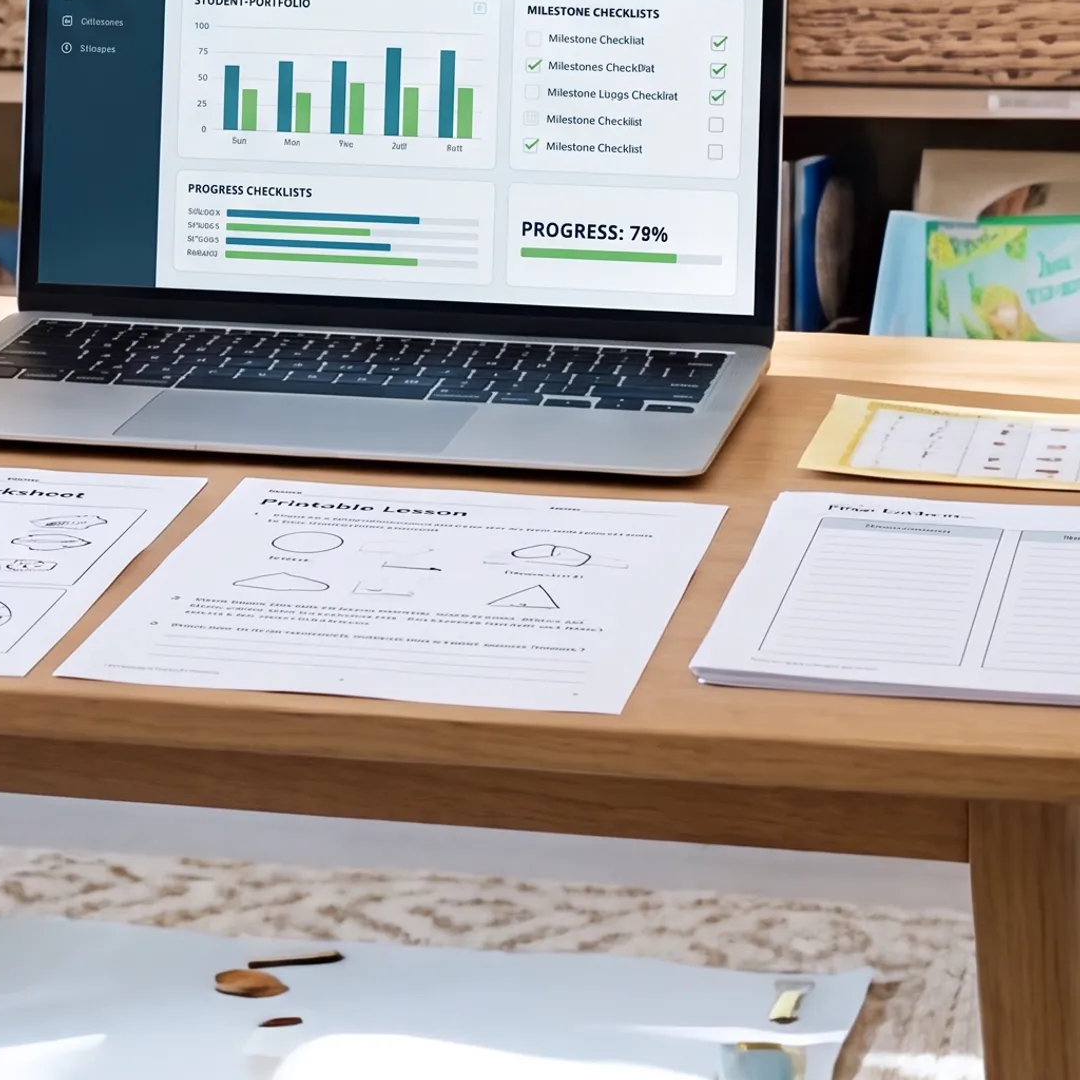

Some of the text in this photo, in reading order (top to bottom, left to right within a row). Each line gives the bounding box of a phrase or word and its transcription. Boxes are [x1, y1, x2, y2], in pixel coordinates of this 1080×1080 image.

[527, 5, 660, 19] MILESTONE CHECKLISTS
[194, 21, 210, 30] 100
[548, 34, 597, 44] Milestone
[198, 47, 209, 56] 75
[548, 61, 603, 71] Milestones
[197, 73, 208, 82] 50
[547, 88, 596, 98] Milestone
[196, 99, 207, 108] 25
[546, 115, 595, 125] Milestone
[201, 125, 207, 133] 0
[284, 139, 301, 147] Mon
[546, 142, 643, 154] Milestone Checklist
[188, 183, 312, 198] PROGRESS CHECKLISTS
[522, 221, 668, 242] PROGRESS: 79%
